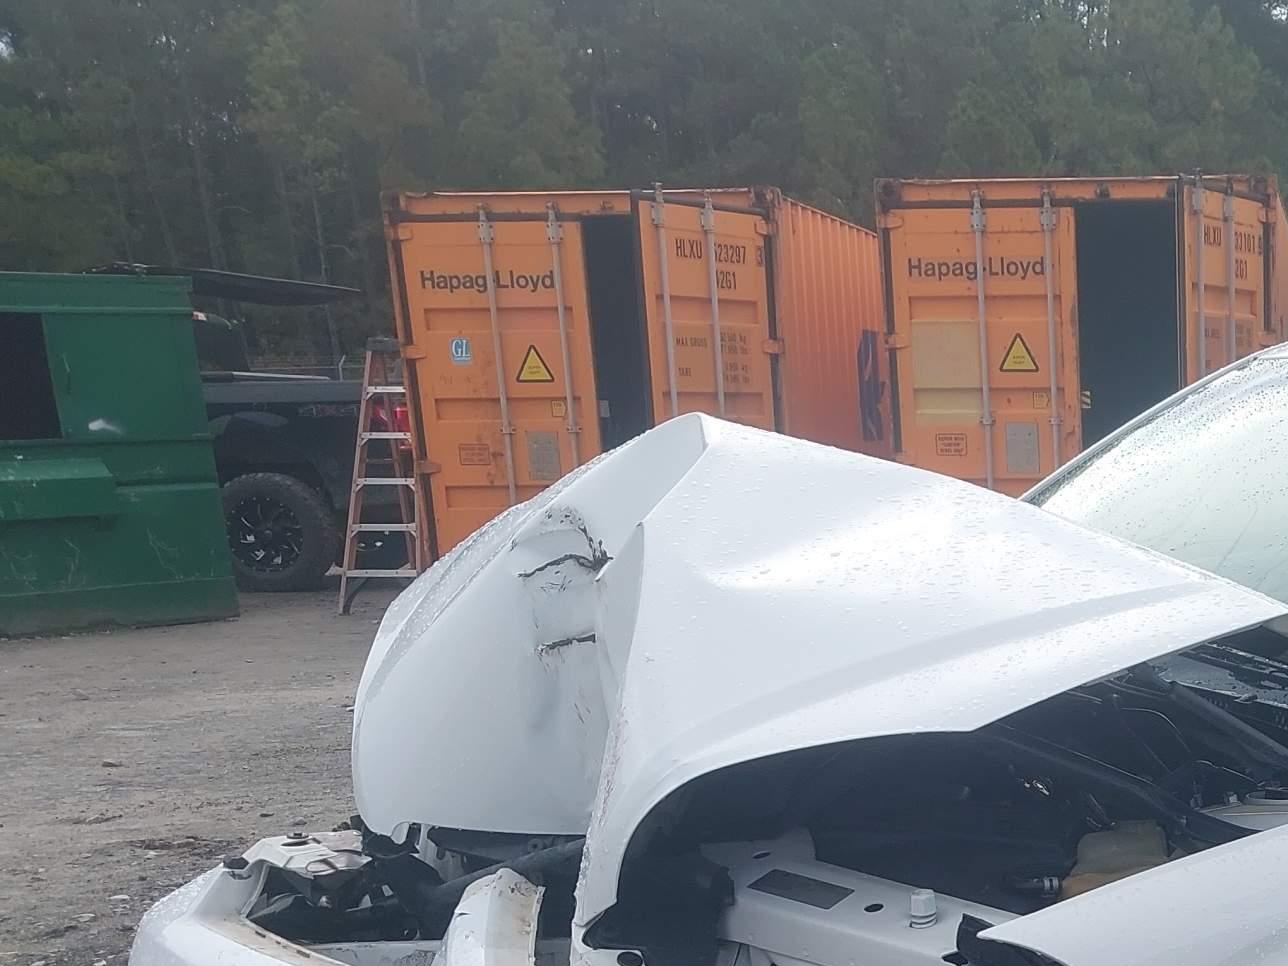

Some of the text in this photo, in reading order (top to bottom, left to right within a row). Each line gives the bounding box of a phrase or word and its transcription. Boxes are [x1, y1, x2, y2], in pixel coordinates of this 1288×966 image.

[1203, 223, 1222, 247] HLXU
[675, 238, 703, 259] HLXU
[452, 339, 471, 358] GL
